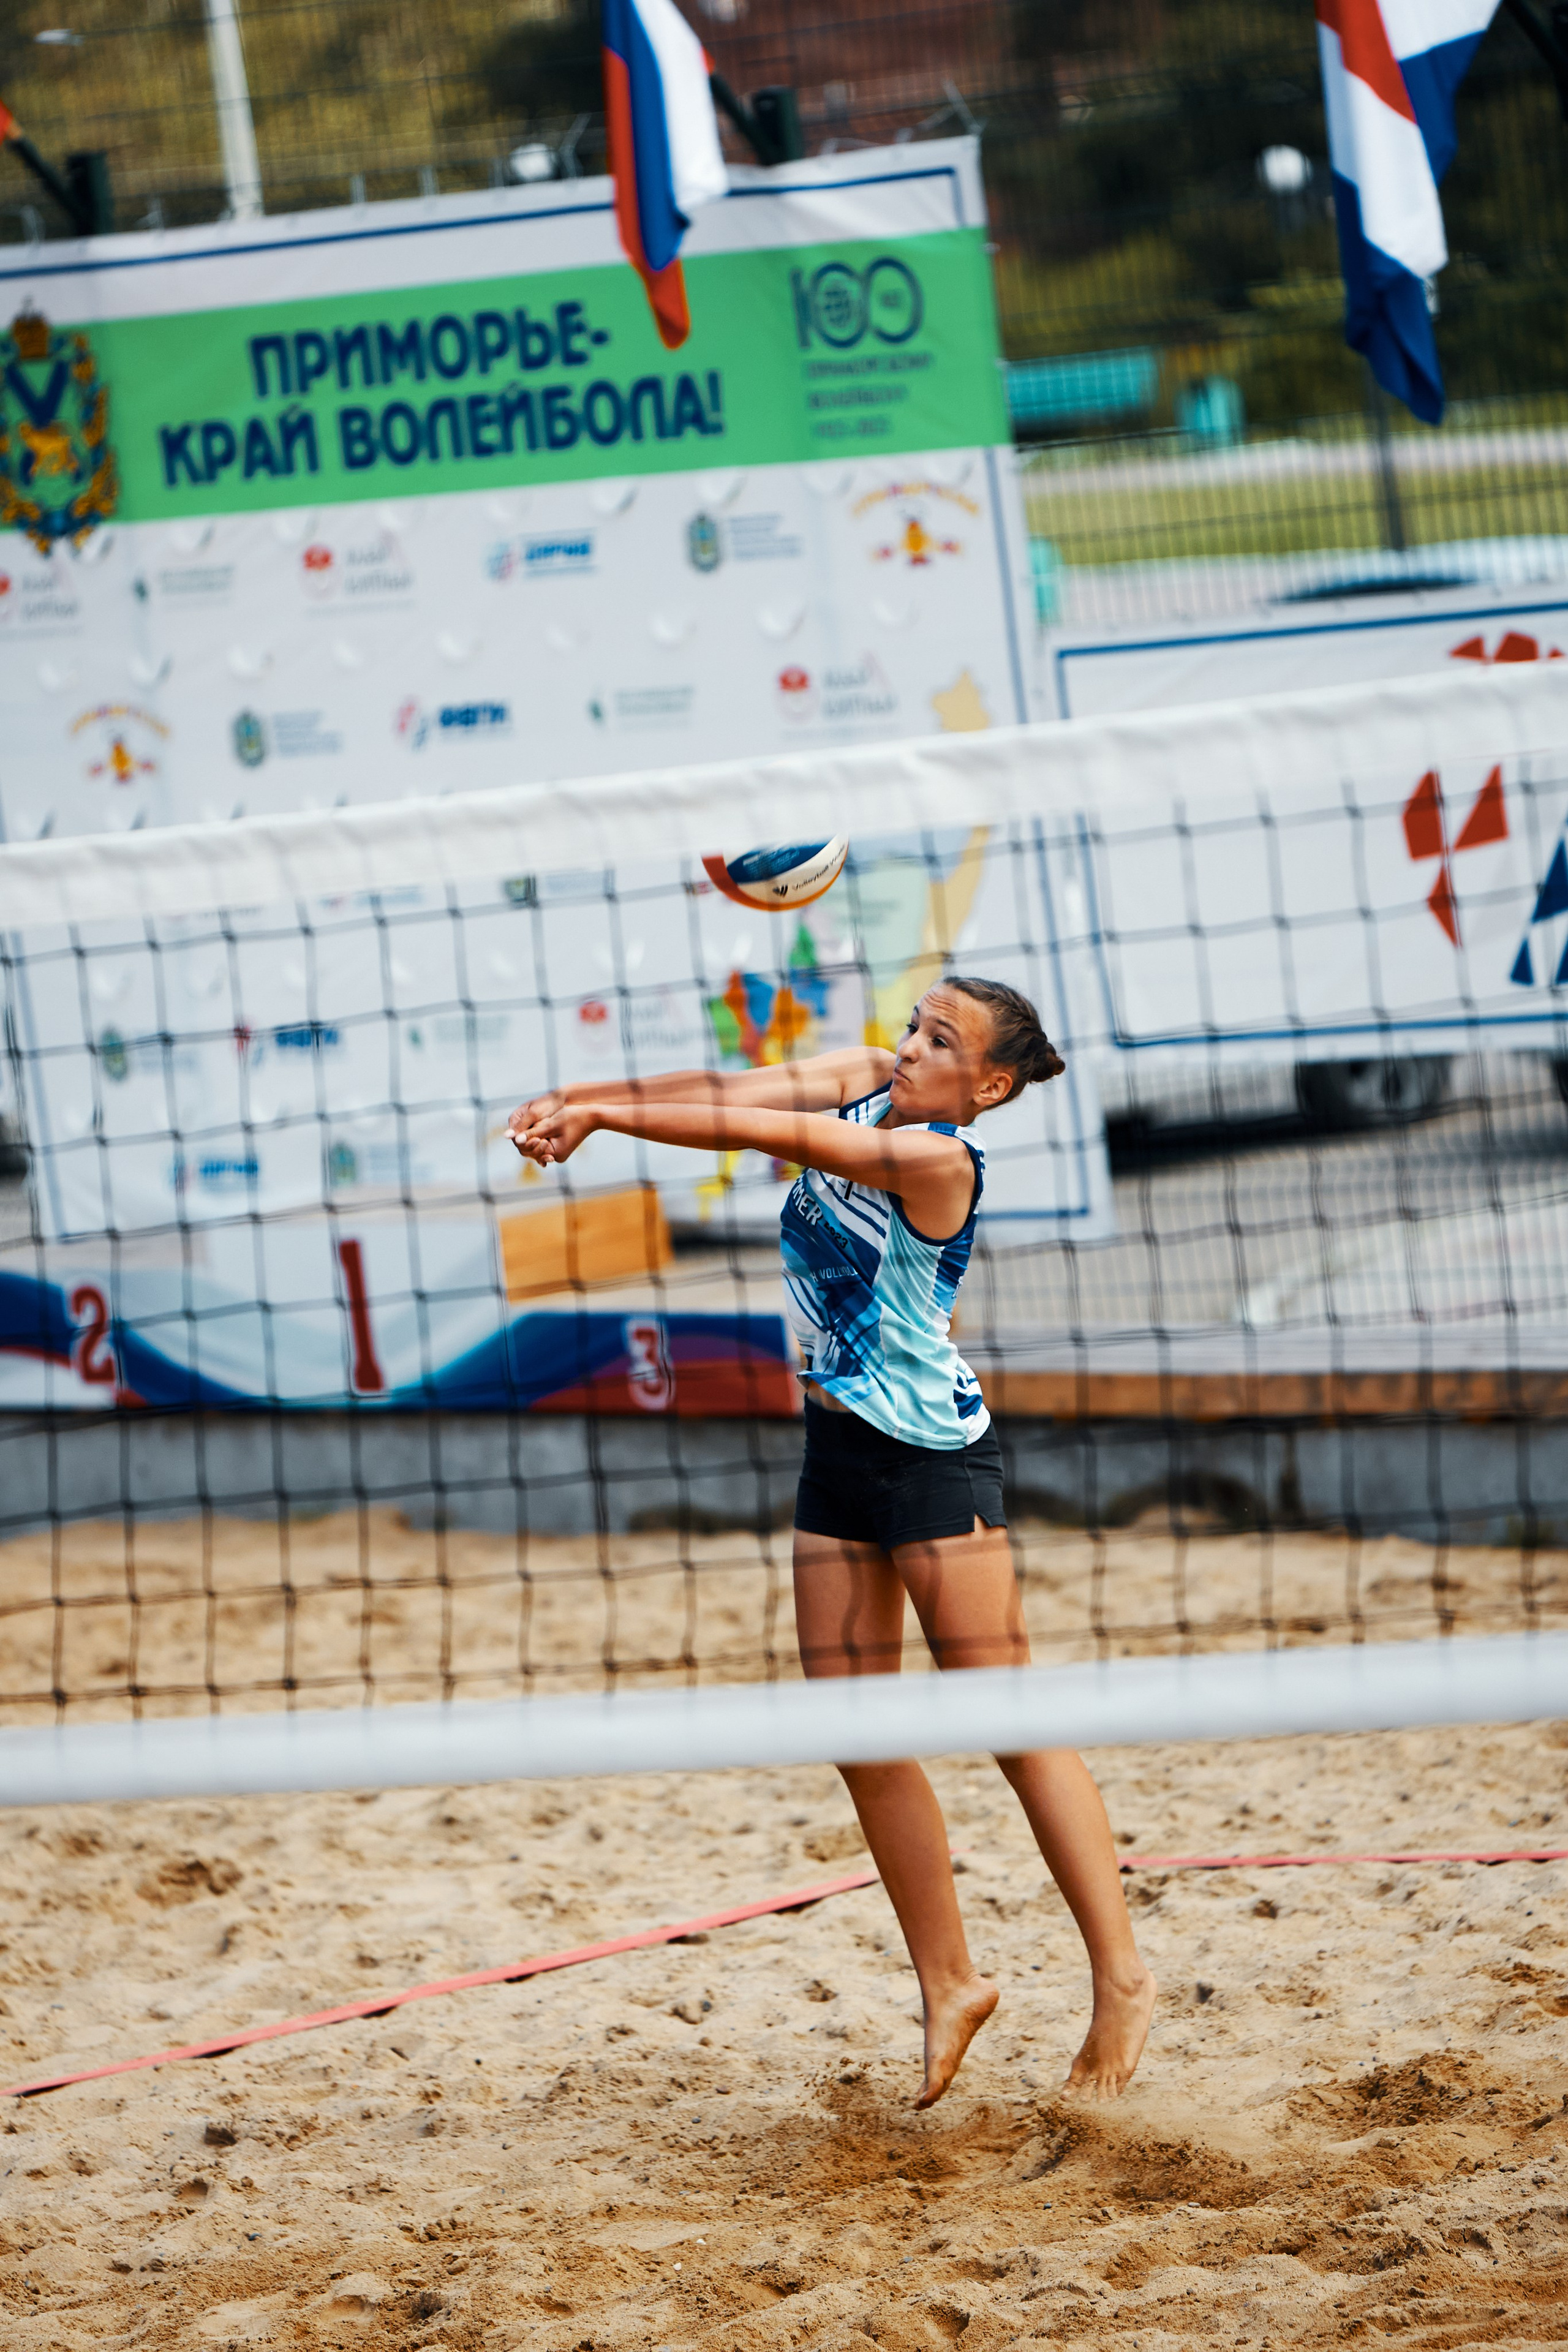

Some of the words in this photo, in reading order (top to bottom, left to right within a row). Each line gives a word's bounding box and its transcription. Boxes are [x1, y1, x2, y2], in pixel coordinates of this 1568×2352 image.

[251, 301, 608, 398] ПРИМОРЬЕ-
[159, 405, 320, 486] КРАЙ
[339, 371, 724, 470] ВОЛЕЙБОЛА!
[823, 1220, 848, 1249] 2023
[71, 1286, 116, 1382] 2
[339, 1238, 384, 1390] 1
